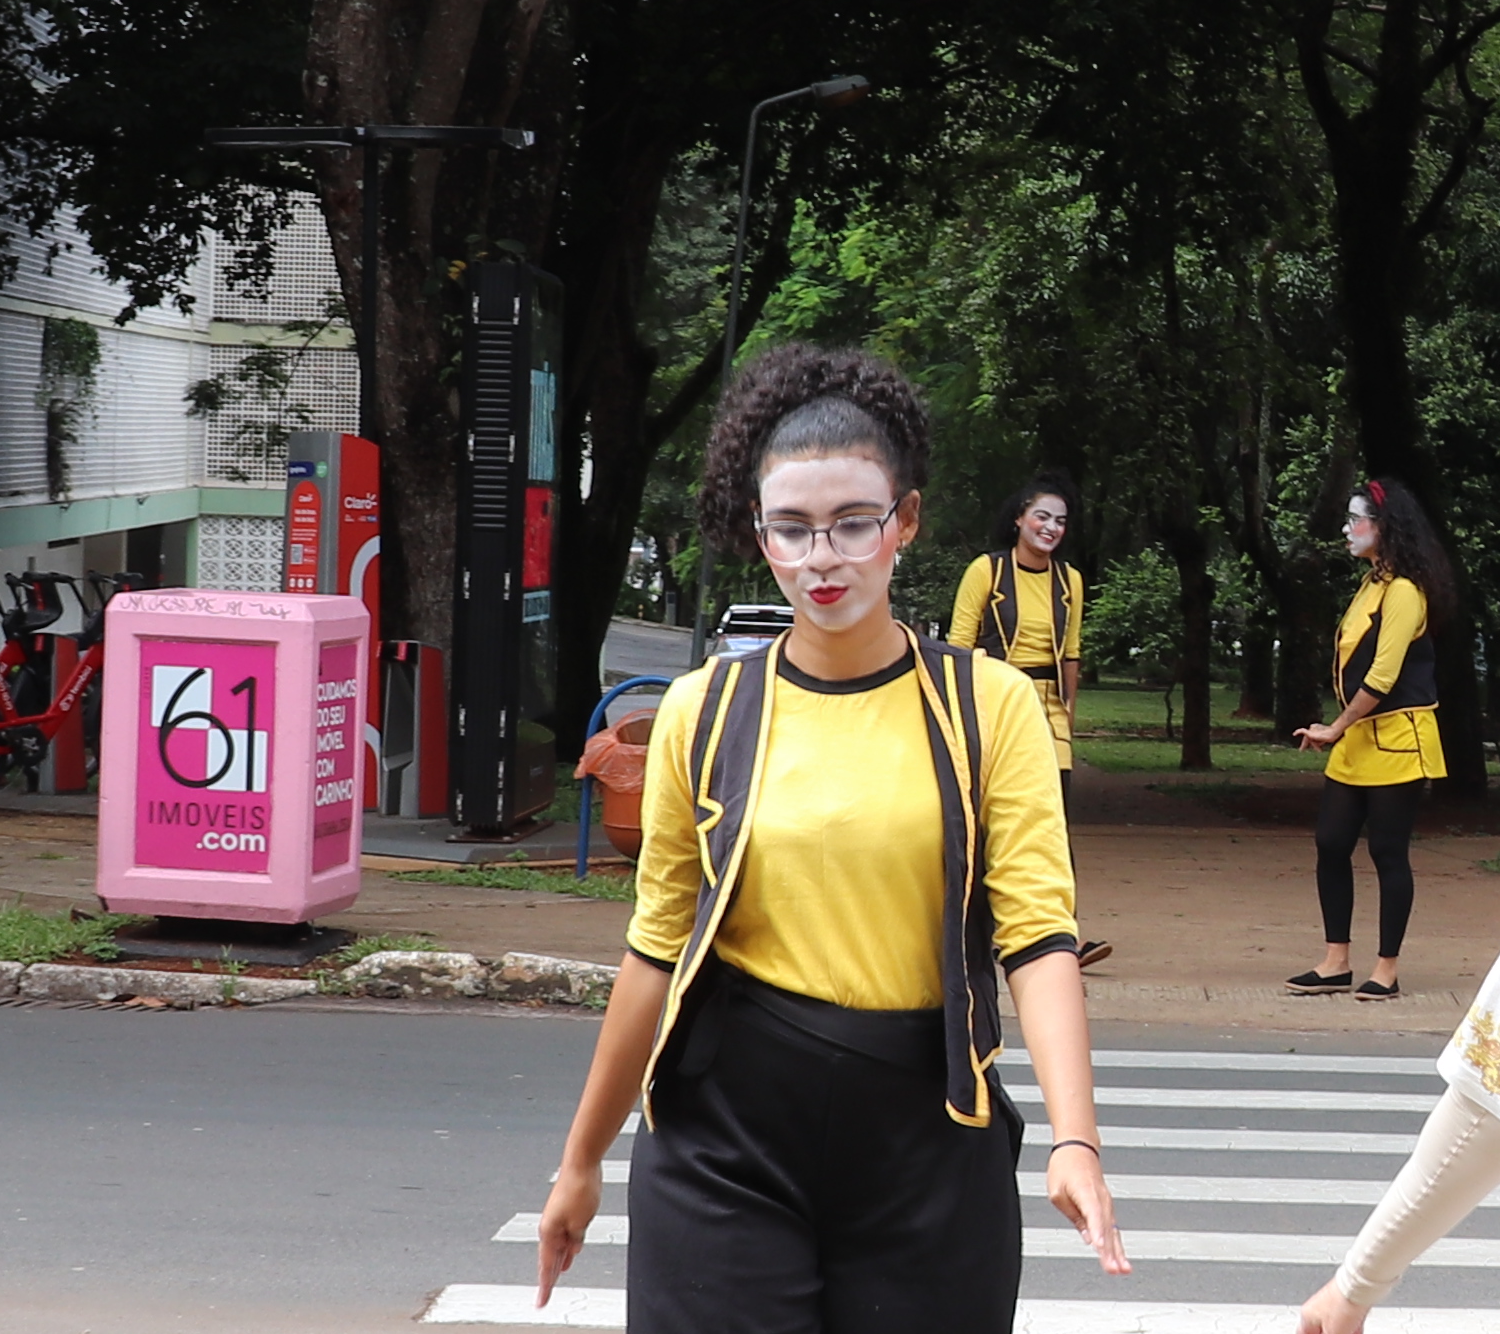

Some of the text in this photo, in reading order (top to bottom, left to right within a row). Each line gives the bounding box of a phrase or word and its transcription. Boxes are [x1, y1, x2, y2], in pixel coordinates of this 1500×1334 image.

[343, 493, 378, 510] Claro
[317, 679, 357, 702] CUIDAMOS
[316, 705, 346, 728] DO SEU
[159, 667, 256, 792] 61
[317, 728, 345, 753] IMÓVEL
[316, 758, 335, 778] COM
[315, 779, 354, 807] CARINHO
[149, 801, 265, 830] IMOVEIS
[196, 831, 266, 852] .com
